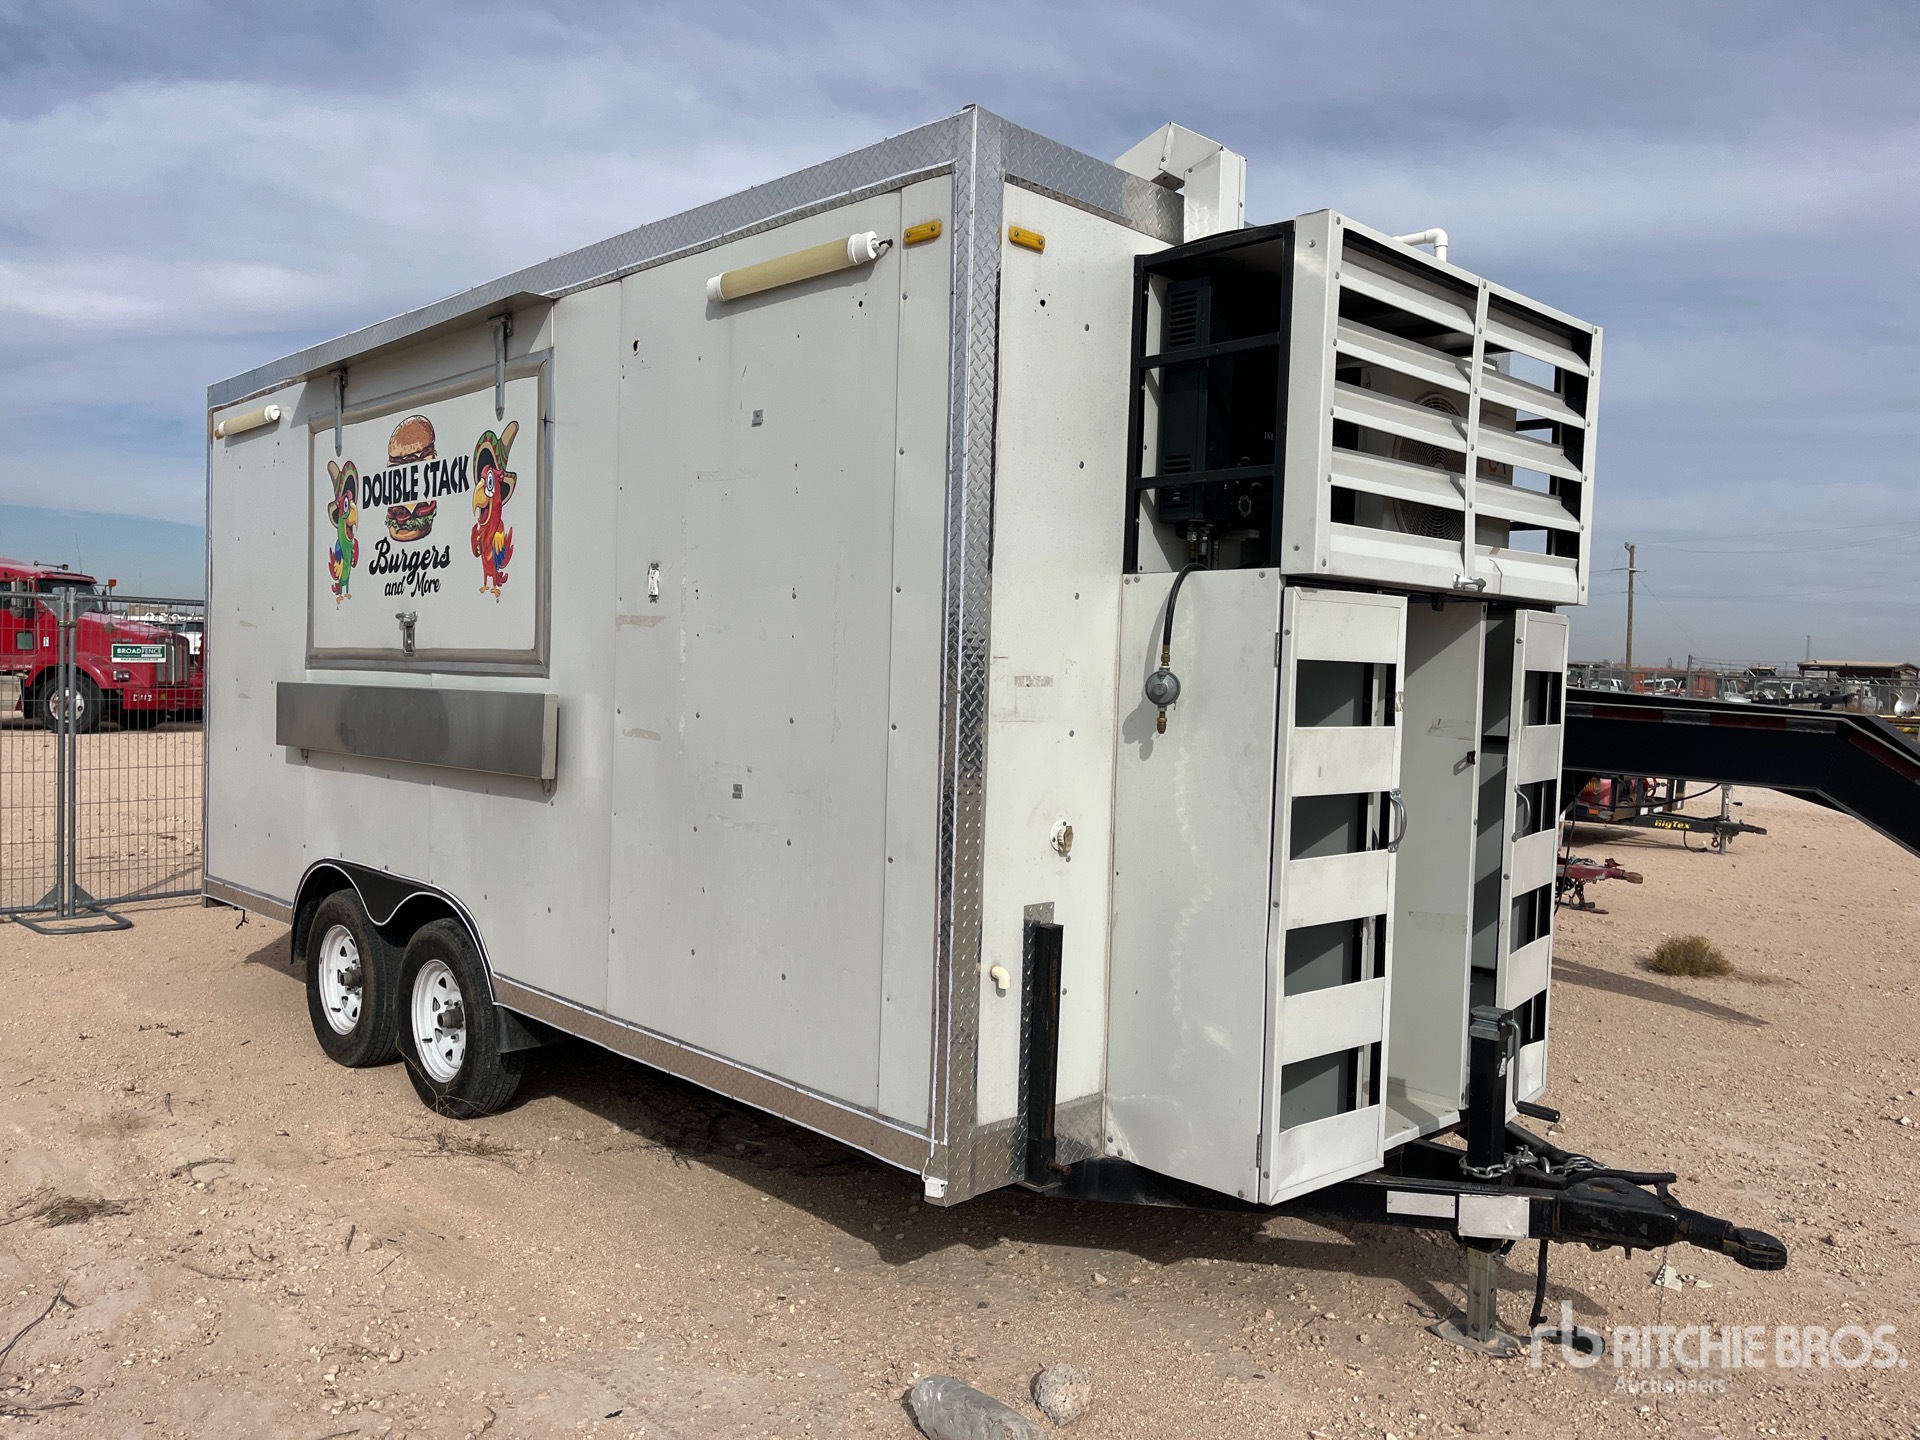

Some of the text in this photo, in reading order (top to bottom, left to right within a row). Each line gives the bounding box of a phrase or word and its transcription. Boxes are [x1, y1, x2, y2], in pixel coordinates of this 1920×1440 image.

[362, 454, 470, 510] DOUBLE STACK
[368, 536, 451, 585] Burgers
[384, 571, 441, 597] and More
